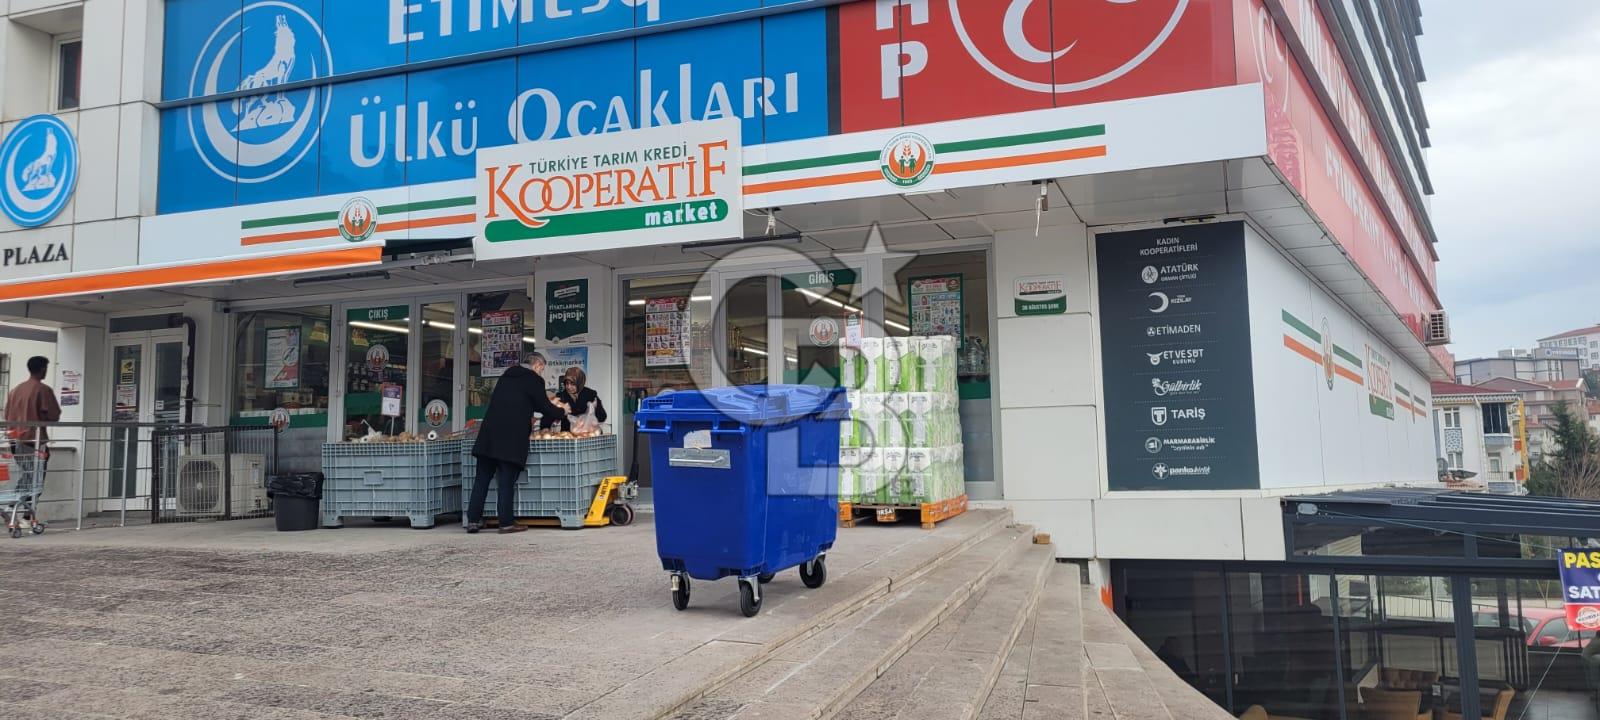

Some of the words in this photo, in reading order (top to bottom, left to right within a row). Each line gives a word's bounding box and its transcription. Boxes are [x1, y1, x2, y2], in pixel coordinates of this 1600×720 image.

[529, 157, 588, 174] TÜRKİYE
[593, 151, 638, 167] TARIM
[644, 141, 688, 161] KREDİ
[484, 140, 728, 227] KOOPERATİF
[645, 202, 718, 226] market
[1156, 237, 1180, 246] KADIN
[3, 243, 69, 266] PLAZA
[1139, 242, 1198, 256] KOOPERATİFLERİ
[1160, 262, 1199, 274] ATATÜRK
[368, 309, 389, 320] ÇIKIŞ
[1156, 324, 1201, 335] ETİMADEN
[1163, 350, 1173, 359] ET
[1174, 349, 1186, 359] VE
[1186, 348, 1204, 358] SÜT
[1171, 407, 1206, 420] TARİŞ
